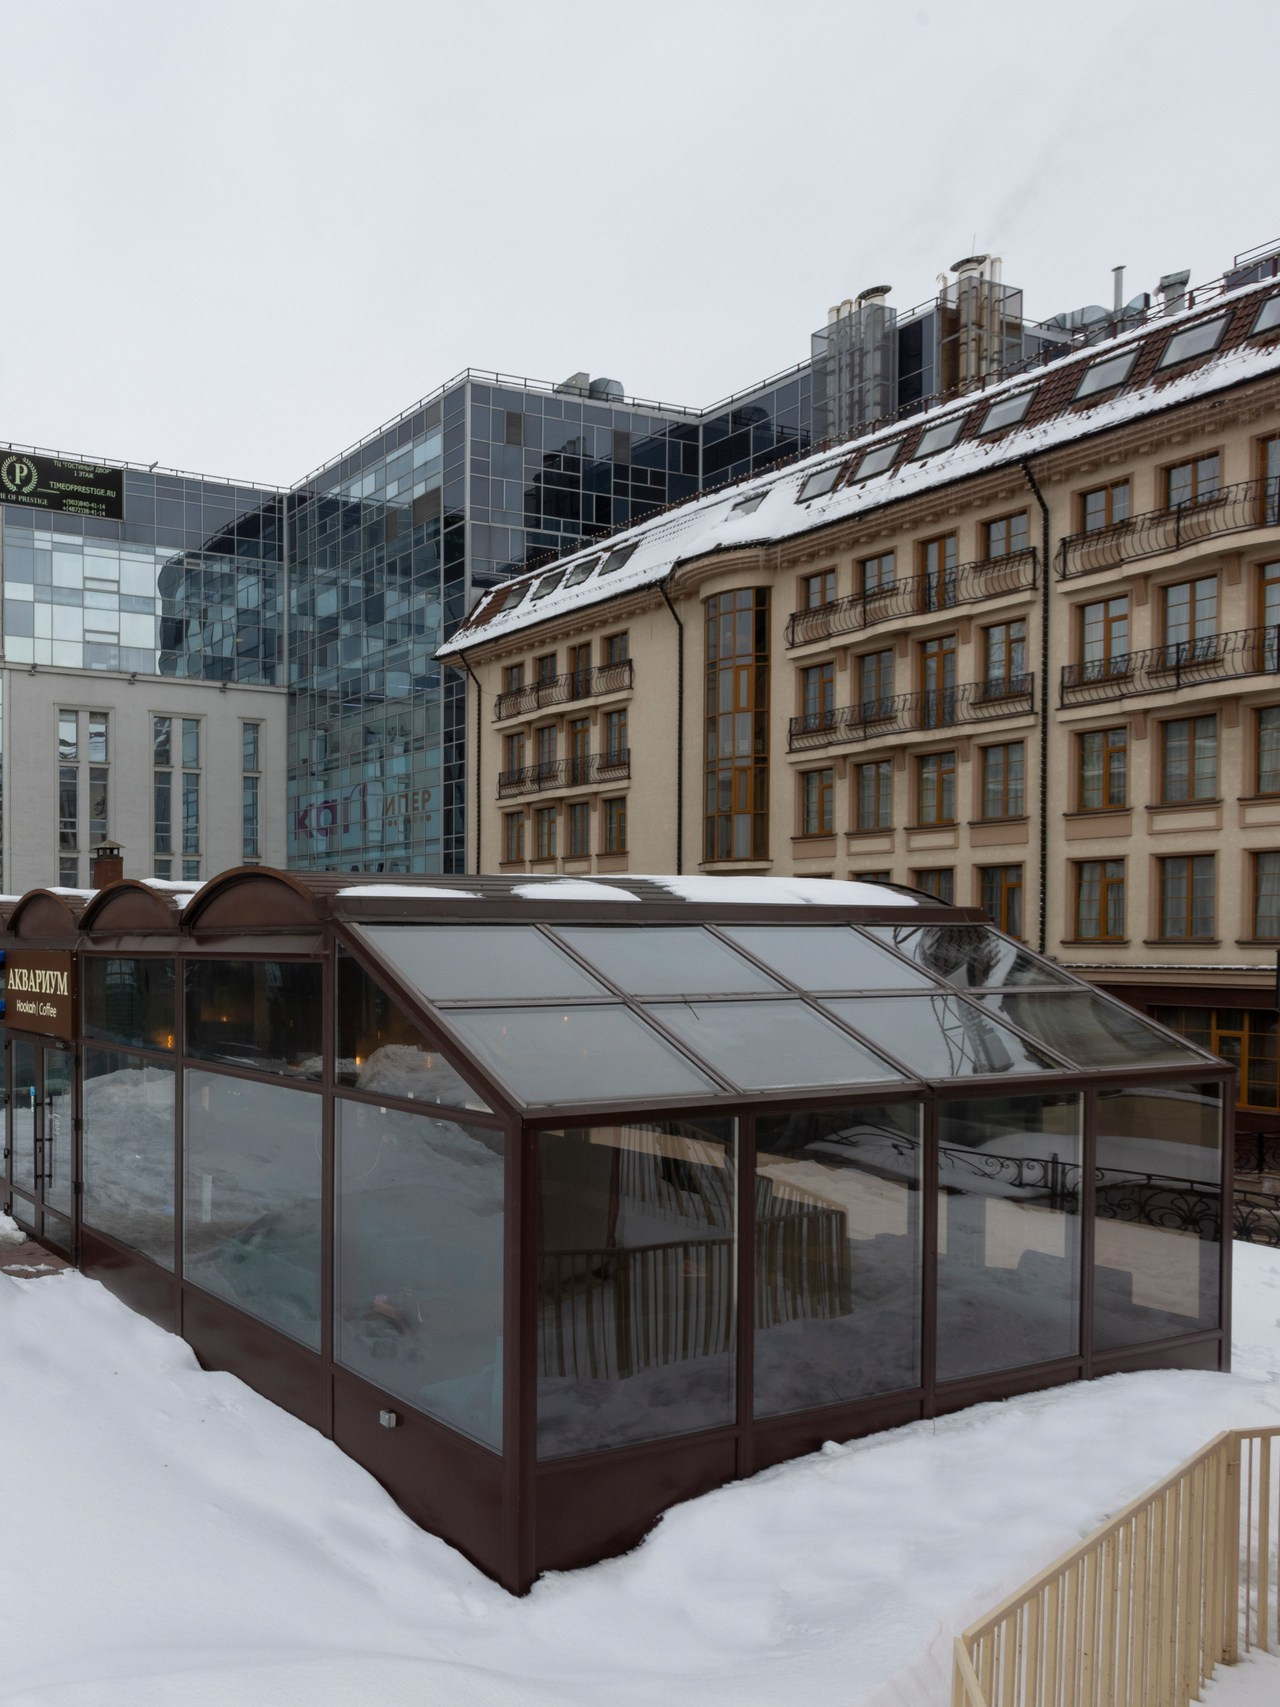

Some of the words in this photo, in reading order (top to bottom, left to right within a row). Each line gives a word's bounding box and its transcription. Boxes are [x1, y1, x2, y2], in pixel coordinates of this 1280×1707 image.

[14, 463, 28, 485] P
[79, 471, 94, 479] ЭТАЖ
[49, 481, 117, 498] TIMEOFPRESTIGE.RU
[18, 495, 48, 505] PRESTIGE
[7, 968, 68, 995] АКВАРИУМ
[16, 1000, 36, 1014] Hookah
[39, 1002, 57, 1017] Coffee
